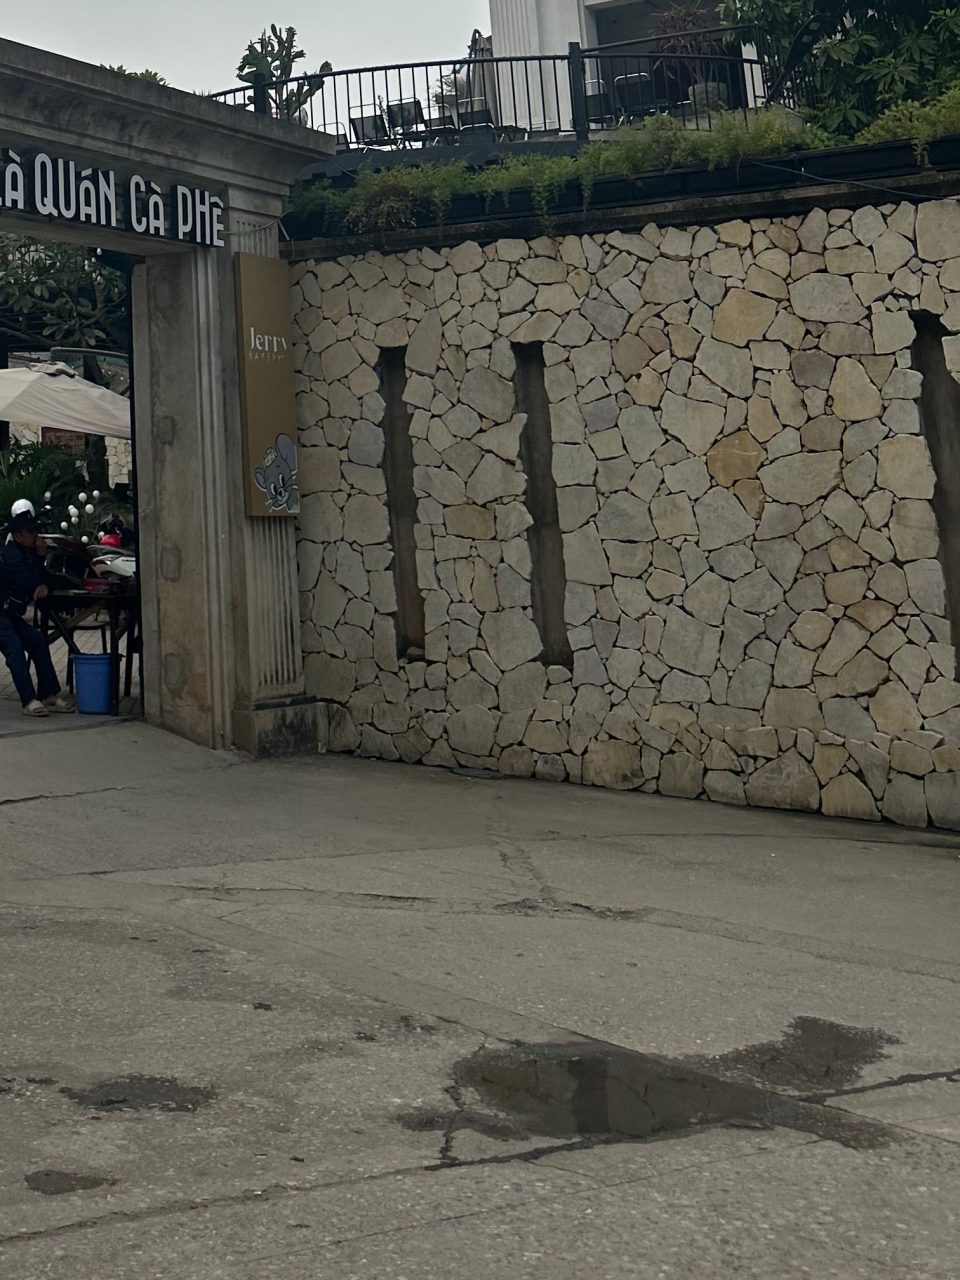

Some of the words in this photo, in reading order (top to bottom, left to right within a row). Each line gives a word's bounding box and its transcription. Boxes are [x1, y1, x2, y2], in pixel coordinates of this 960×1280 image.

[34, 152, 116, 227] QUÁN
[130, 175, 165, 236] CÀ
[177, 185, 225, 247] PHÊ
